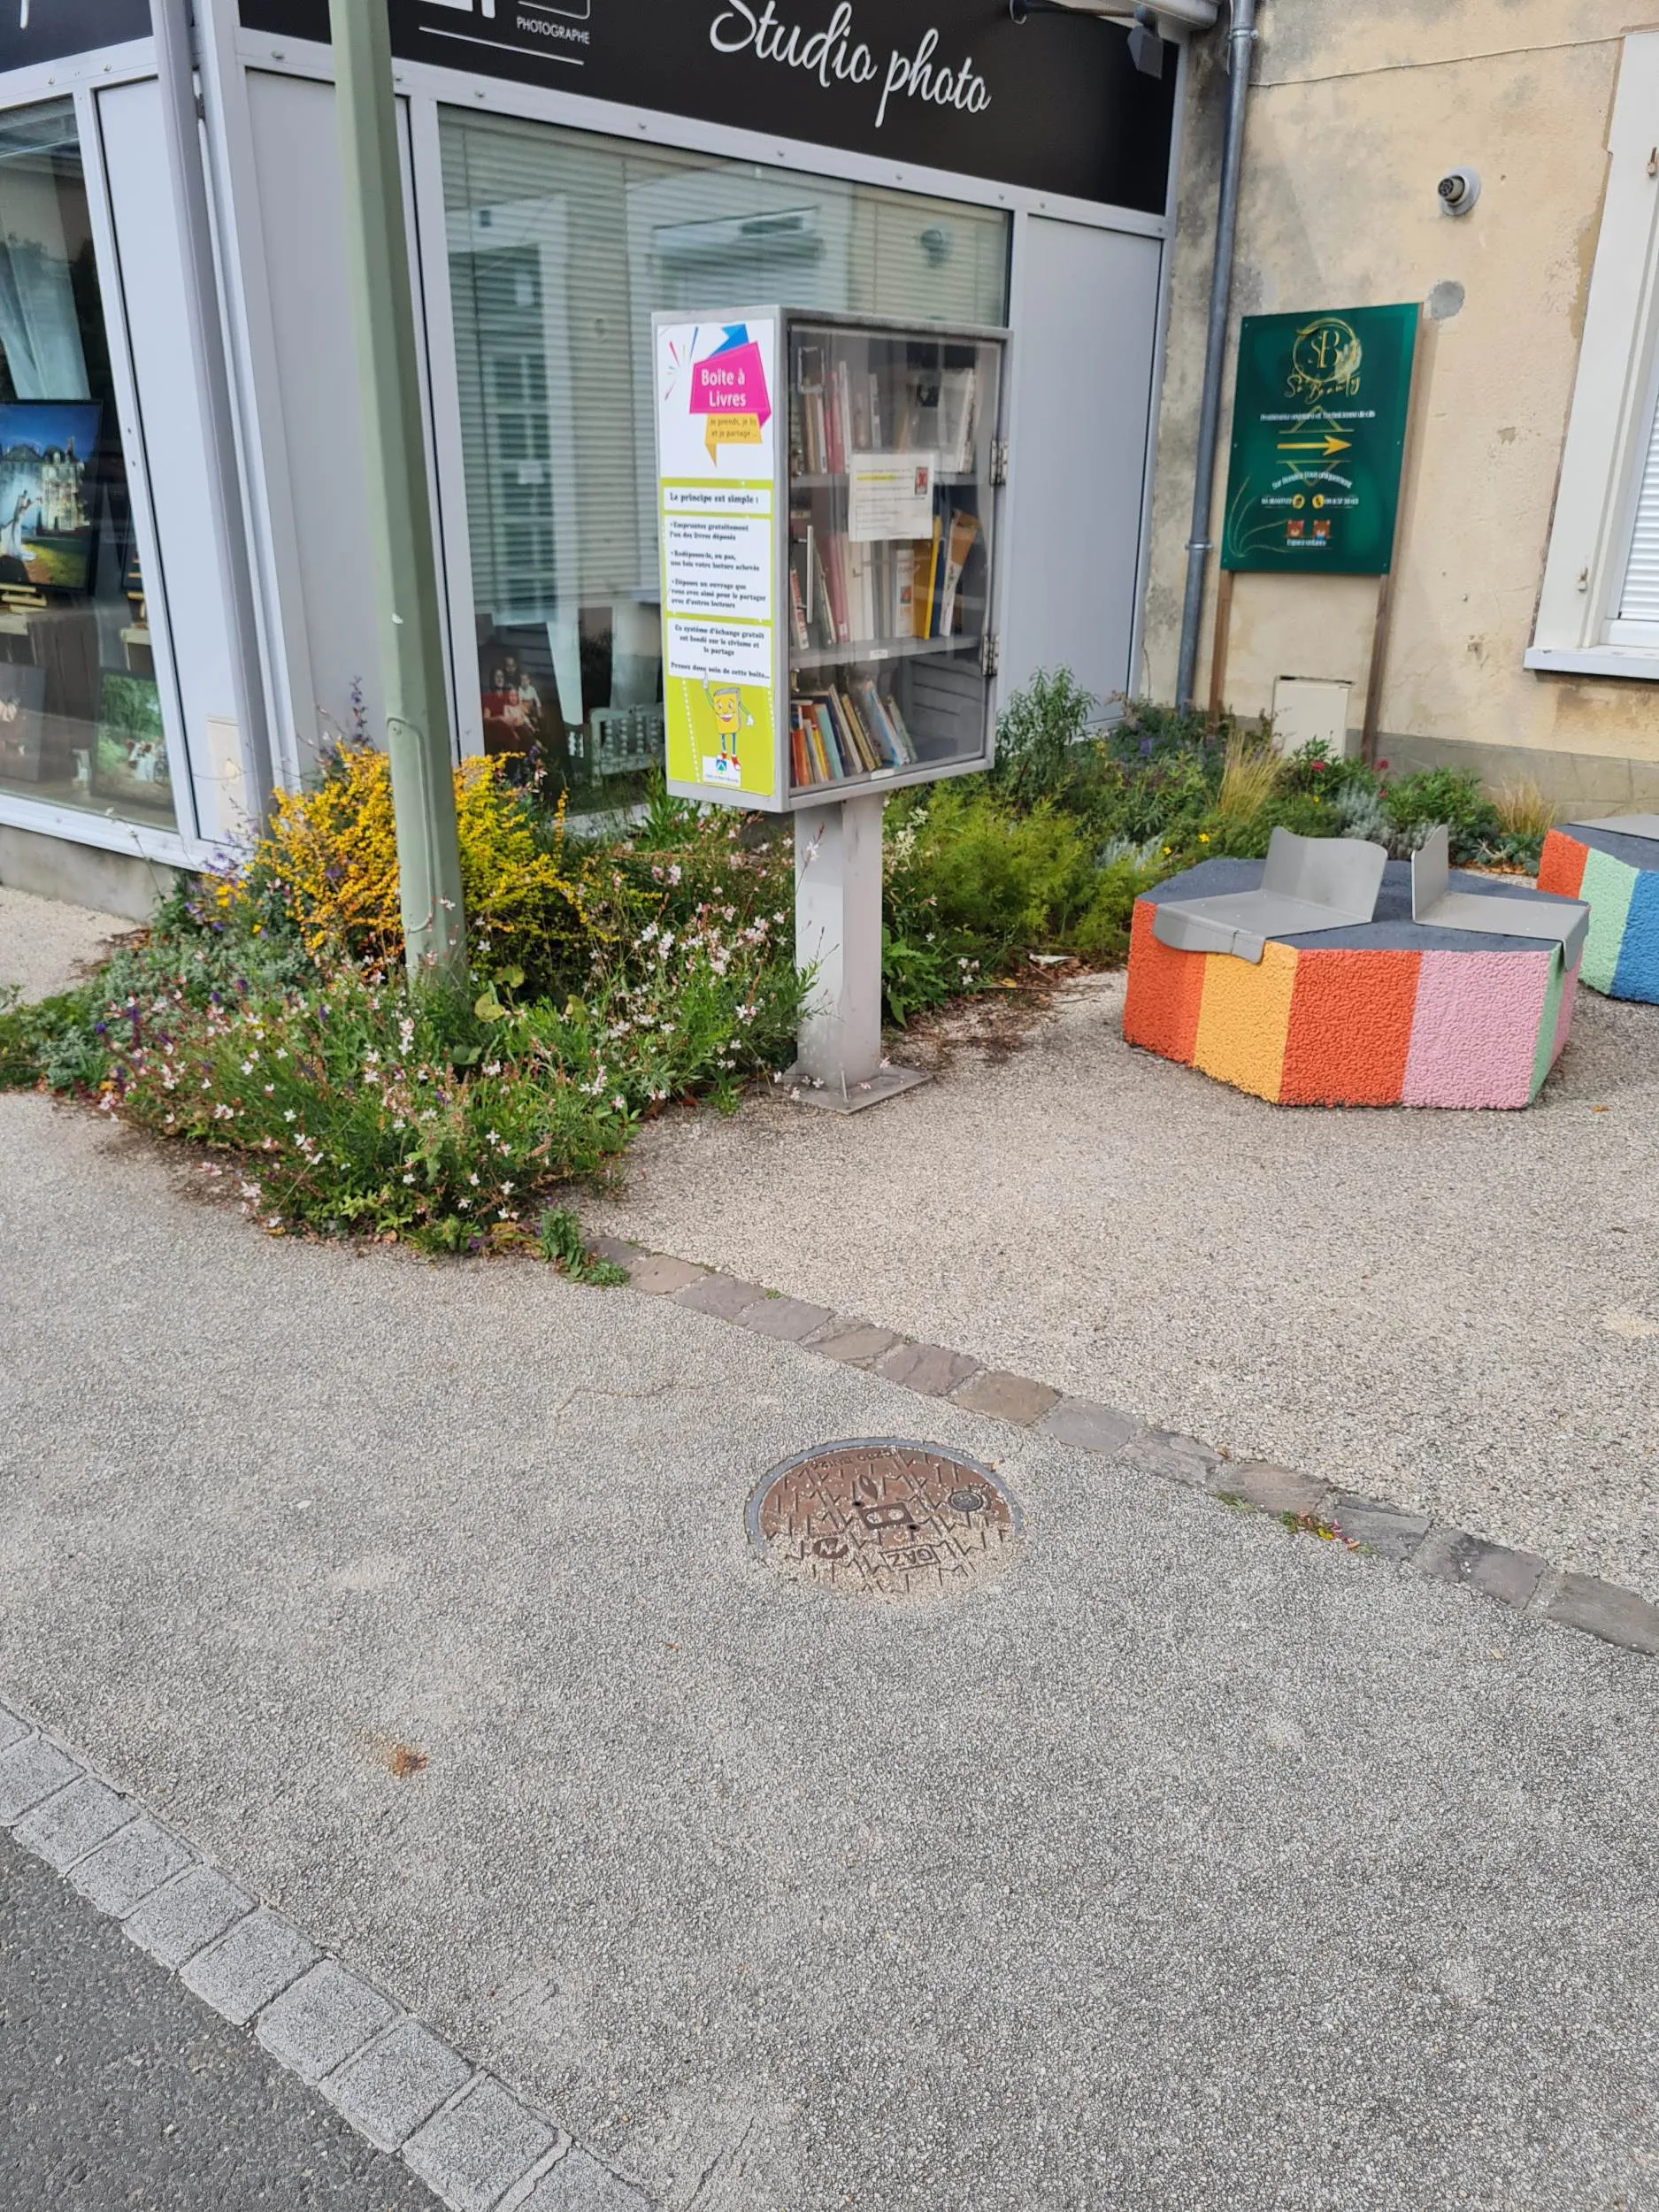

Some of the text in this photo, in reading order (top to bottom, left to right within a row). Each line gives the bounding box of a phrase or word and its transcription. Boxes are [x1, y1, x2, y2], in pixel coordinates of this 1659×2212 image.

[515, 16, 590, 45] PHOTOGRAPHE
[710, 0, 992, 128] Studio photo
[701, 367, 745, 387] Boîte à
[709, 389, 746, 408] Livres
[670, 492, 678, 502] Le
[680, 494, 711, 503] principe
[728, 495, 754, 504] simple
[710, 581, 733, 590] ouvrage
[739, 594, 766, 603] partager
[741, 631, 764, 640] gratuit
[710, 648, 734, 657] partage
